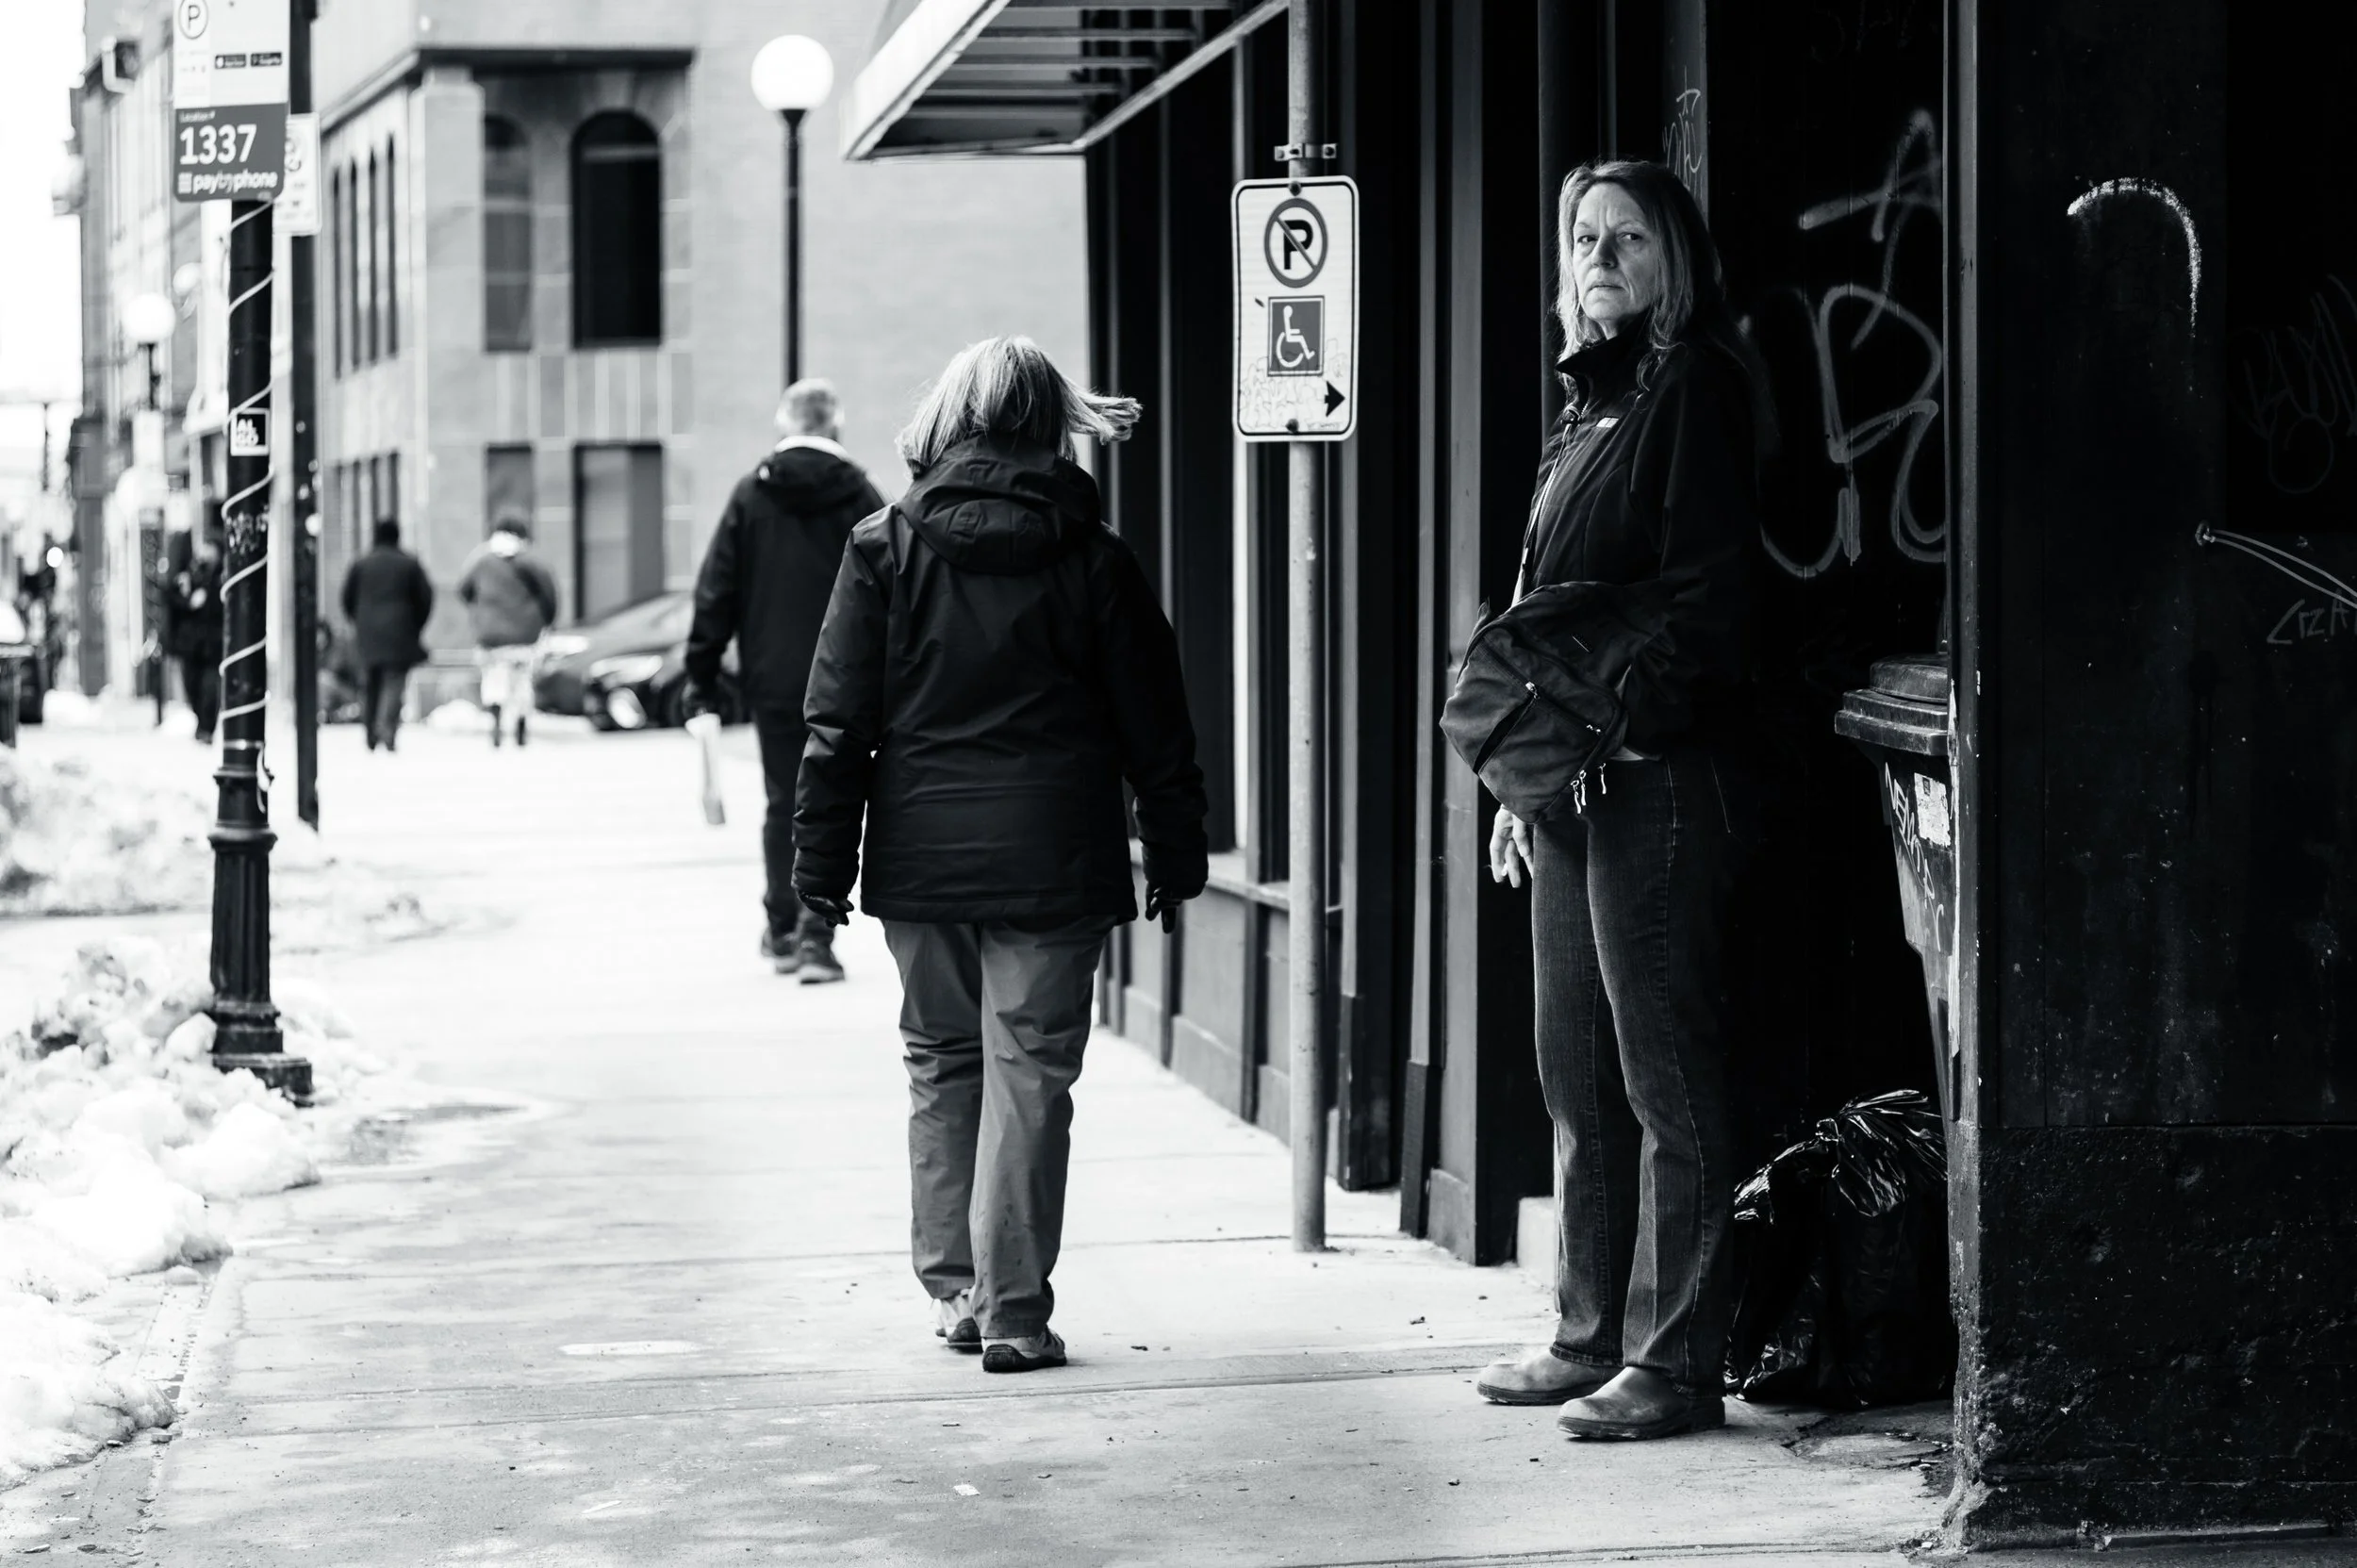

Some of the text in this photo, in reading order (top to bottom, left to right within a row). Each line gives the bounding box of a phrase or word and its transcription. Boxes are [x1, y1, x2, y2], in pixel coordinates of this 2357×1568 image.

[188, 5, 201, 30] P
[179, 124, 257, 165] 1337
[192, 169, 278, 194] paybyphone
